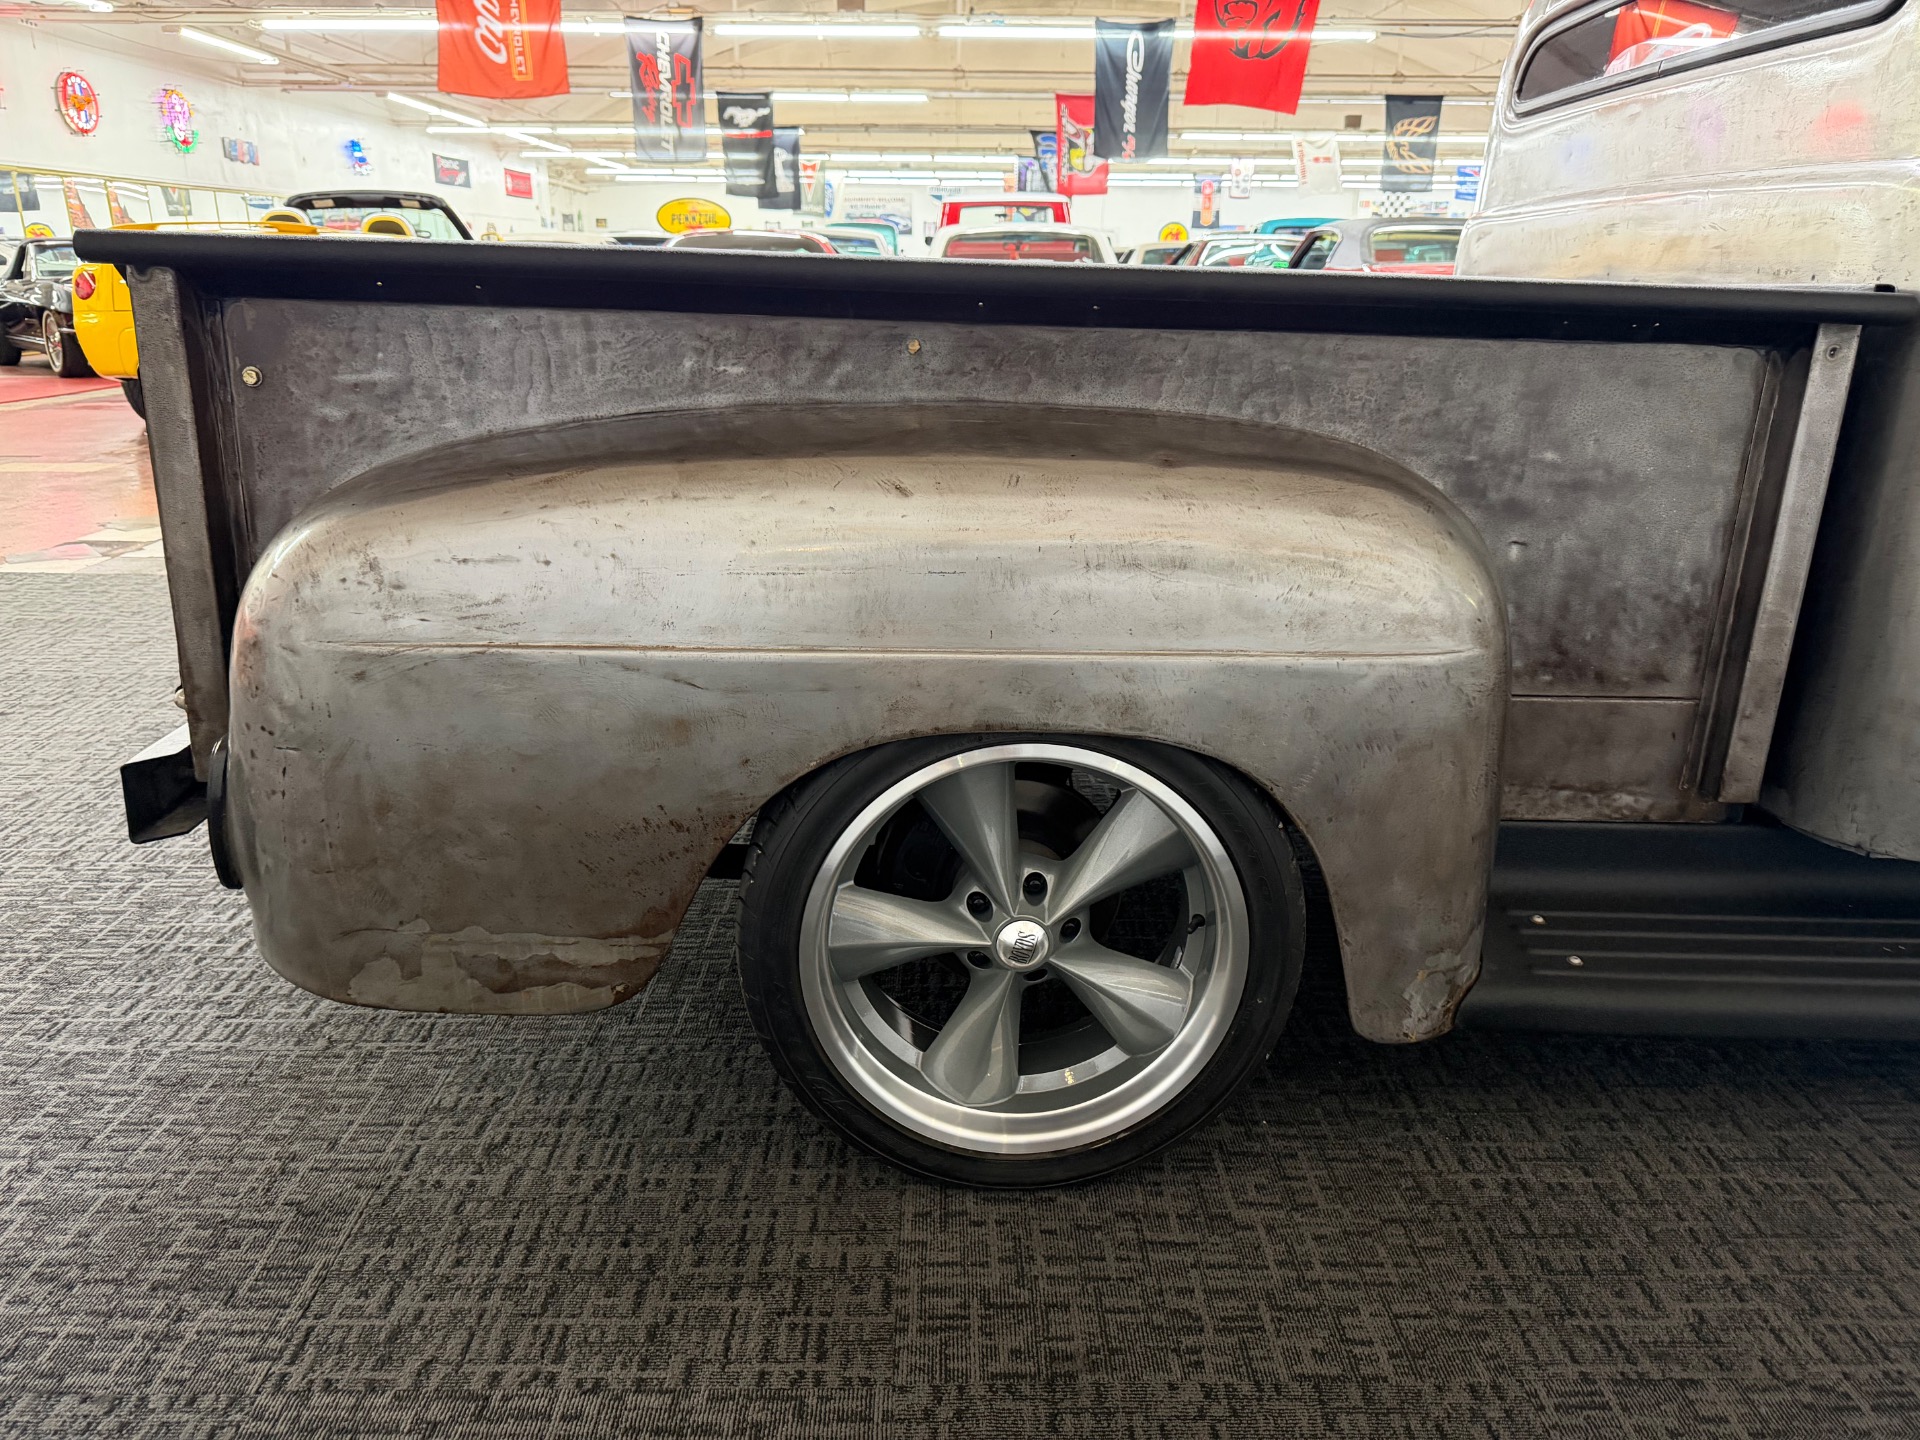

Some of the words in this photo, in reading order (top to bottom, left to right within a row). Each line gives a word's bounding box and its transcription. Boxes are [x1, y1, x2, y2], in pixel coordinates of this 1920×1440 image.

[509, 0, 526, 74] HEVROLET
[655, 31, 675, 155] CHEVROLET
[1120, 30, 1145, 133] Charger
[1008, 931, 1038, 964] BOYDS
